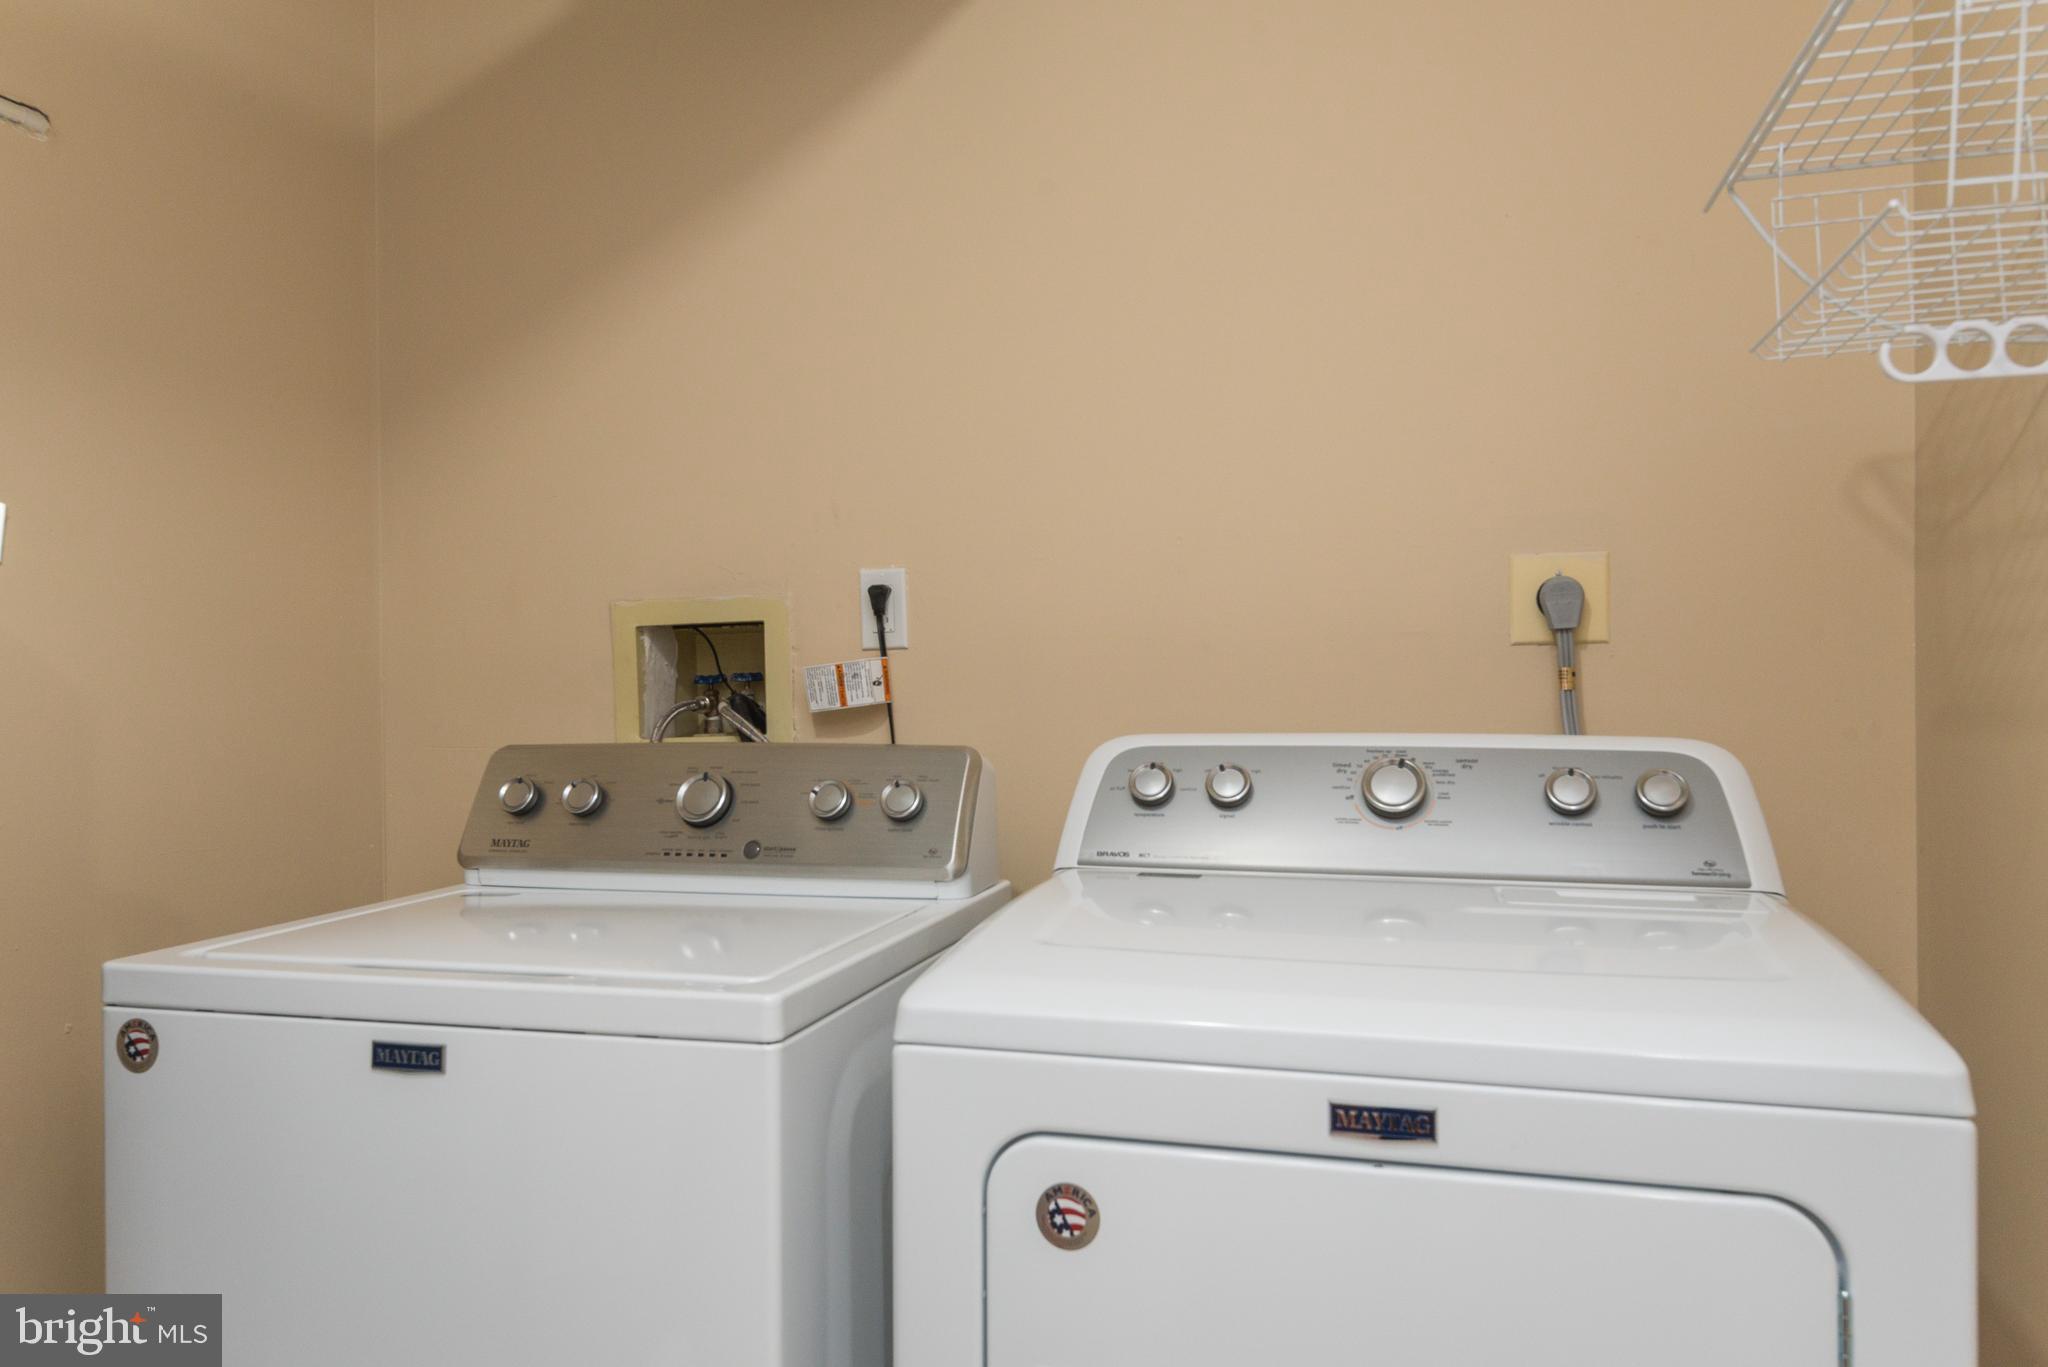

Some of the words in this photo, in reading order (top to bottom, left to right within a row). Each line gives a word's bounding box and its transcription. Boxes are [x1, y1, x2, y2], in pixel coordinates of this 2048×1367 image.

[490, 838, 530, 849] MAYTAG
[375, 1046, 441, 1067] MAYTAG
[1335, 1107, 1433, 1135] MAYTAG
[1044, 1184, 1097, 1219] AMERICA
